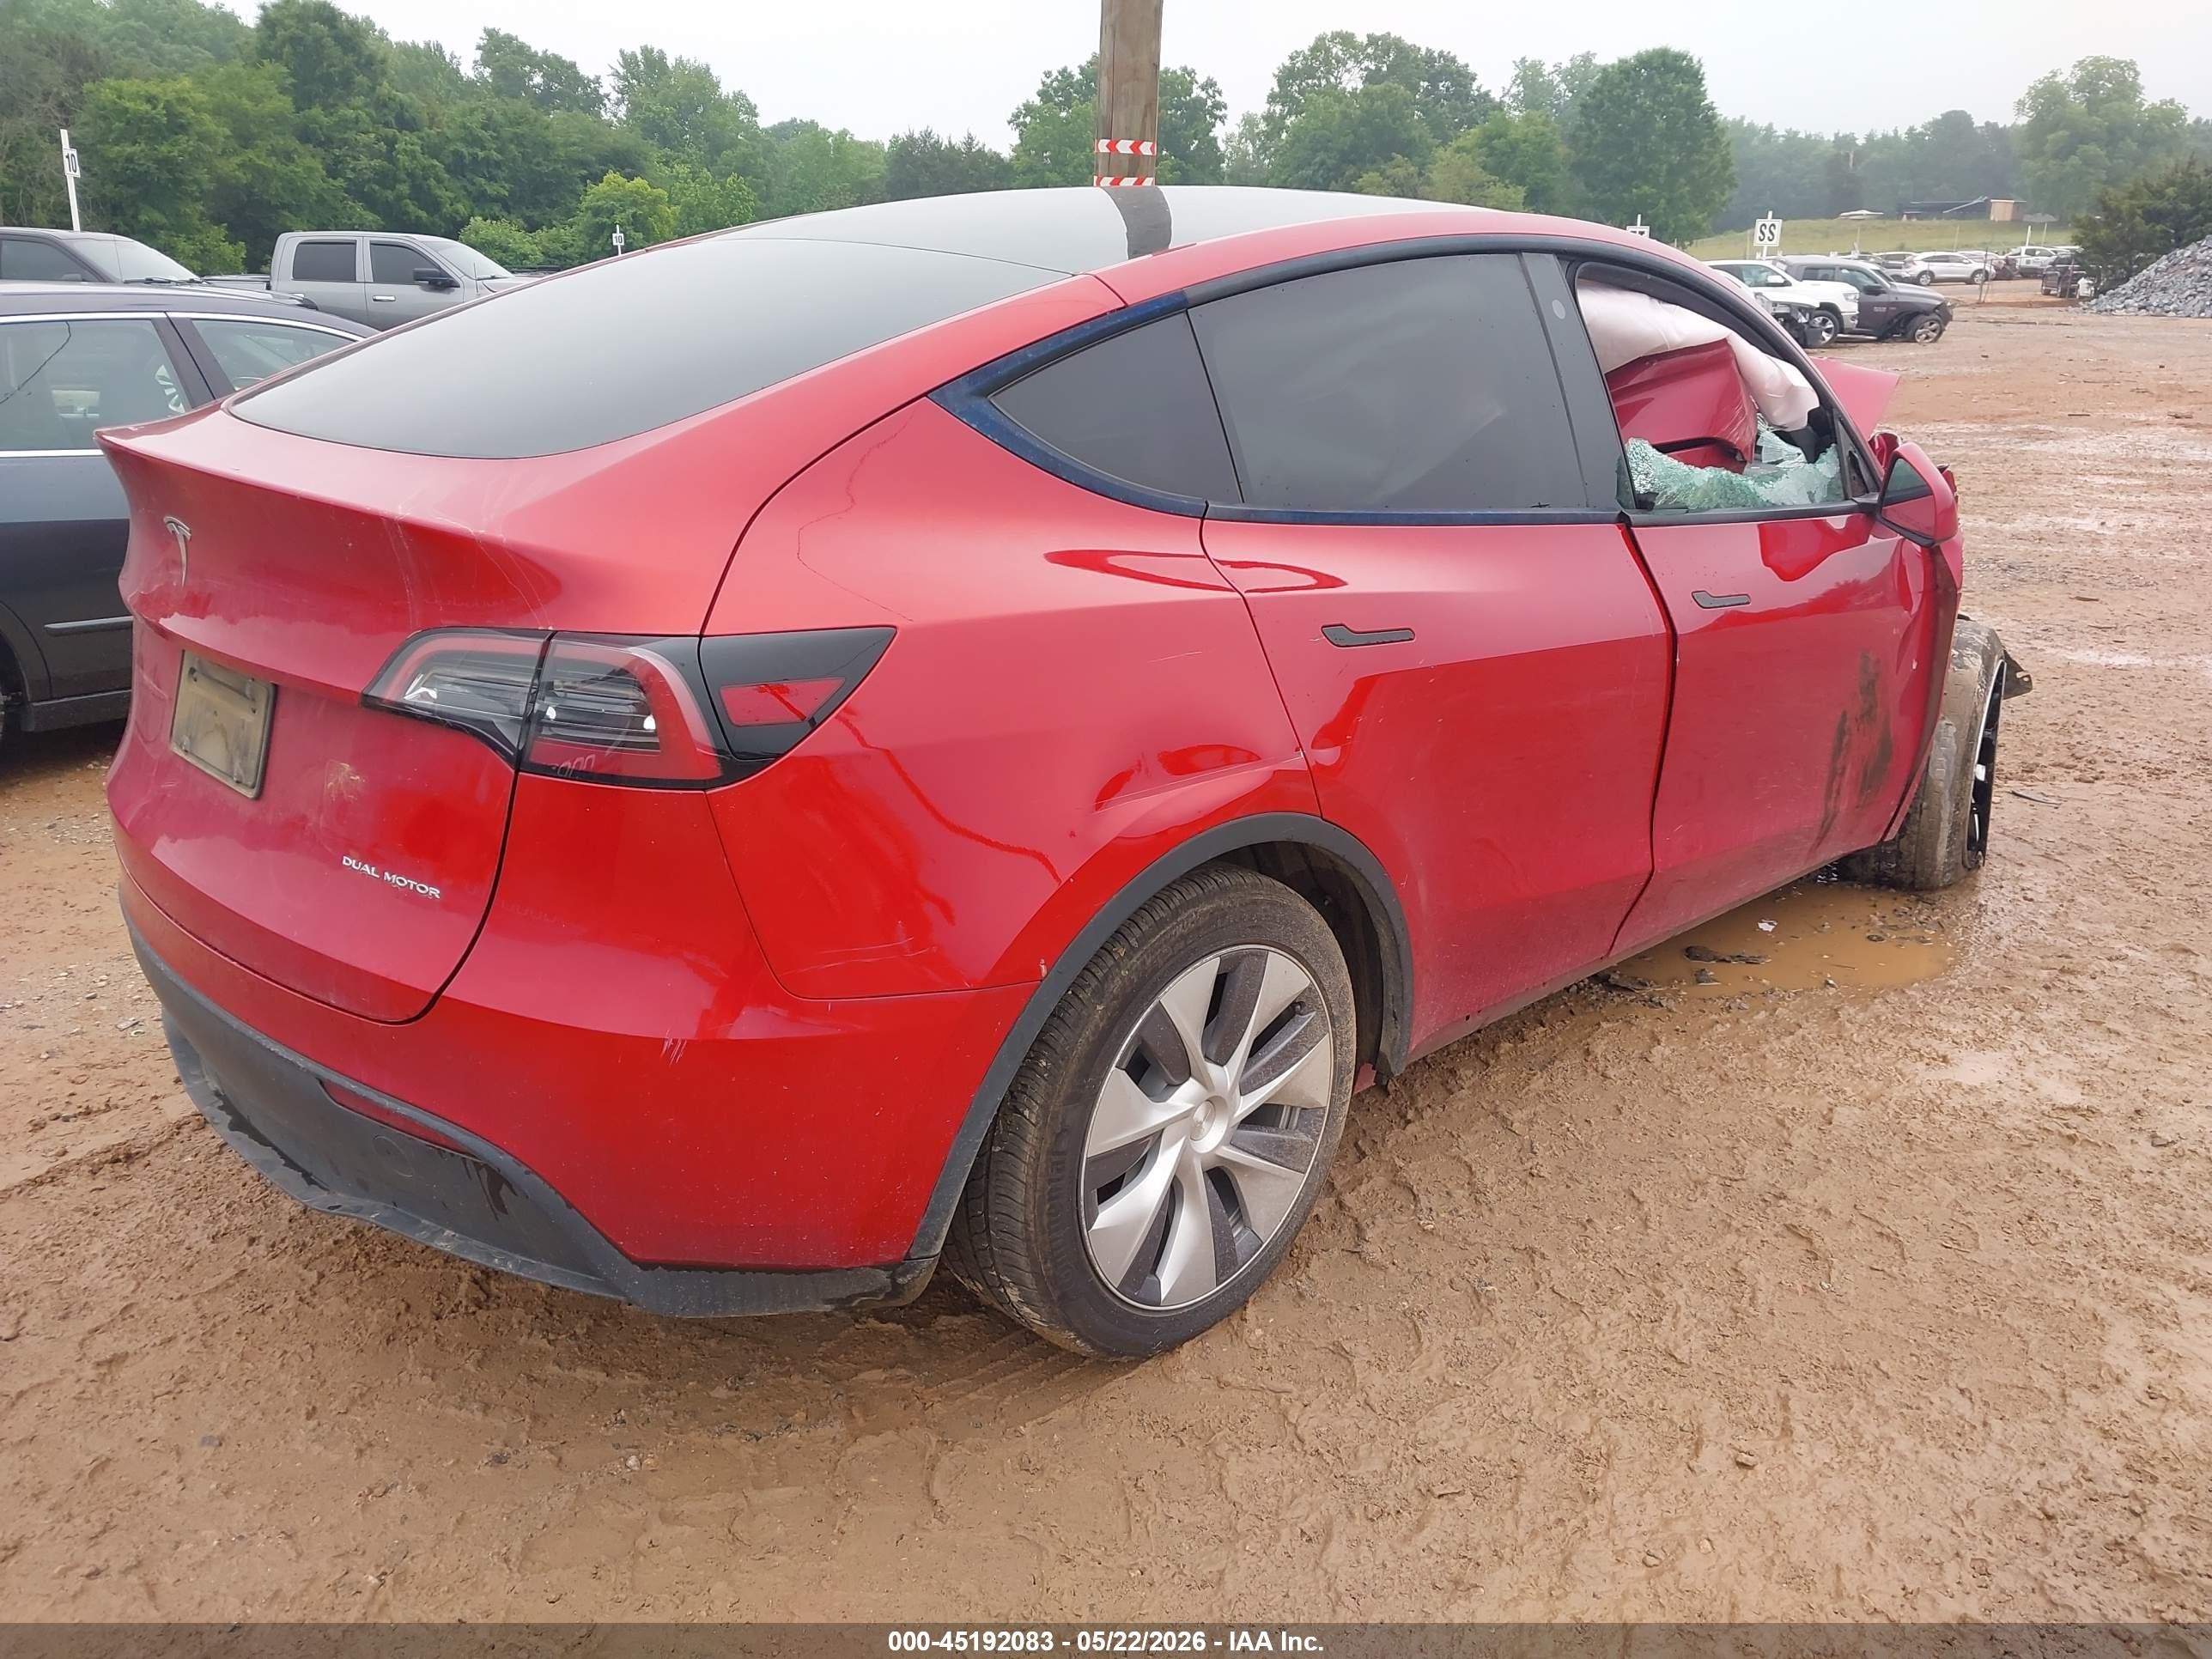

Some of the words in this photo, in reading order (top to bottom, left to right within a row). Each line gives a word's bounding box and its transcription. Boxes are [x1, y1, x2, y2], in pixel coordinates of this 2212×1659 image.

[65, 153, 77, 173] 10
[613, 234, 623, 244] 10
[1758, 222, 1777, 242] SS
[342, 855, 380, 878] DUAL
[383, 871, 441, 899] MOTOR
